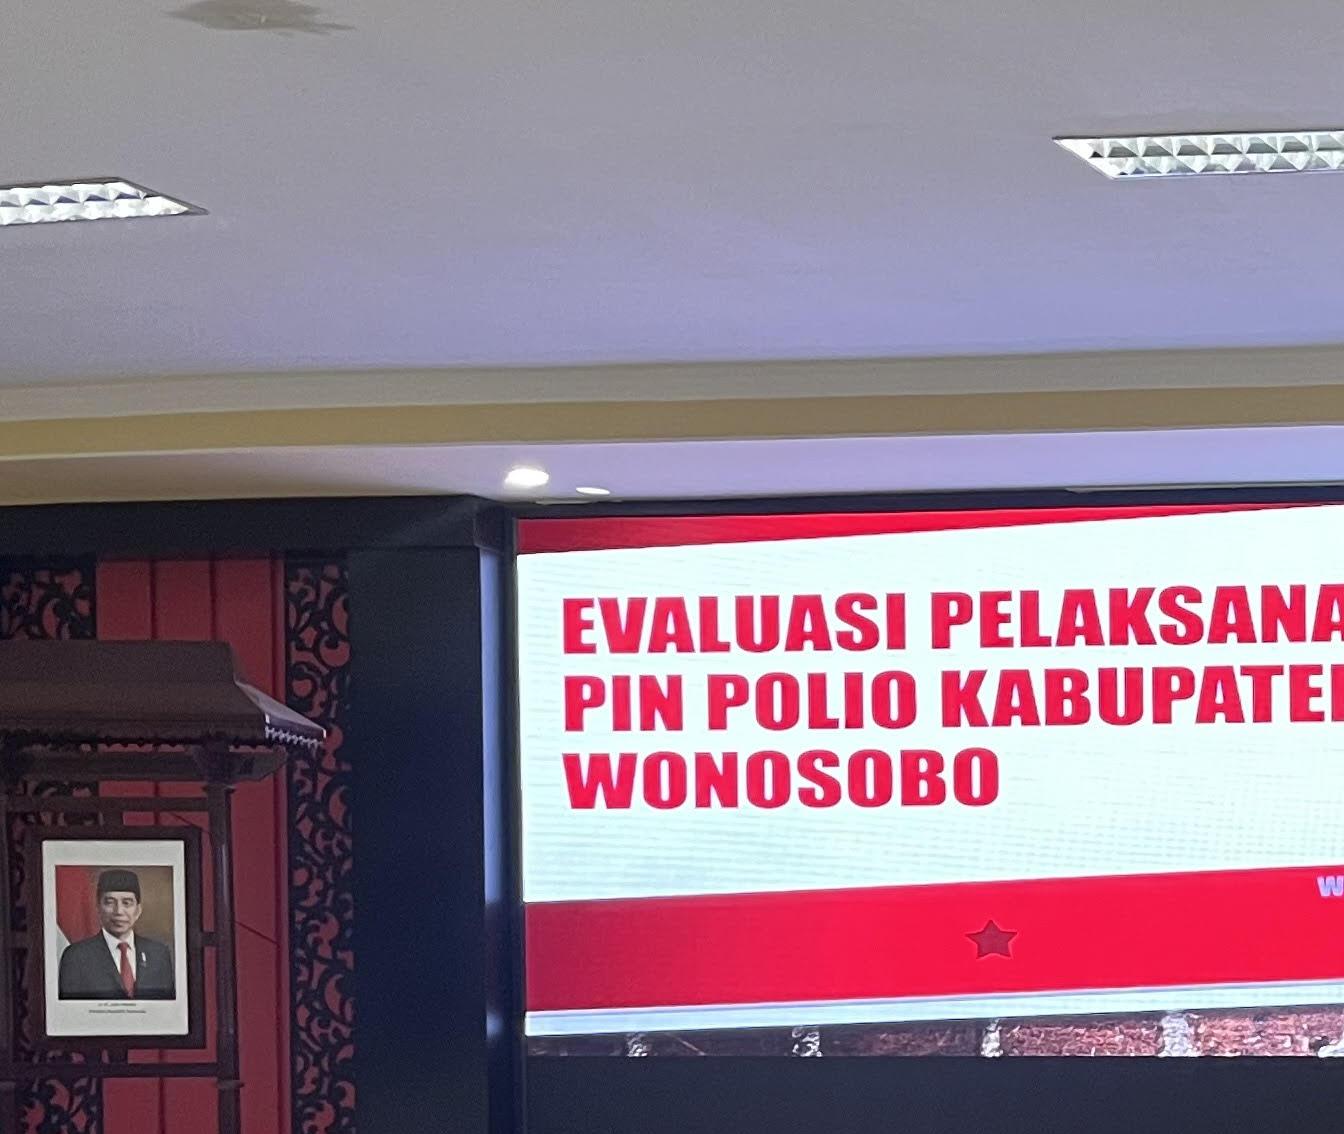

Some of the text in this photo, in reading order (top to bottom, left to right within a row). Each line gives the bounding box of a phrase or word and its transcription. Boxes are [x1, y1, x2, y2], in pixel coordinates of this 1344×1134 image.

[563, 593, 906, 654] EVALUASI
[564, 674, 683, 732] PIN
[707, 670, 917, 731] POLIO
[563, 747, 1000, 810] WONOSOBO
